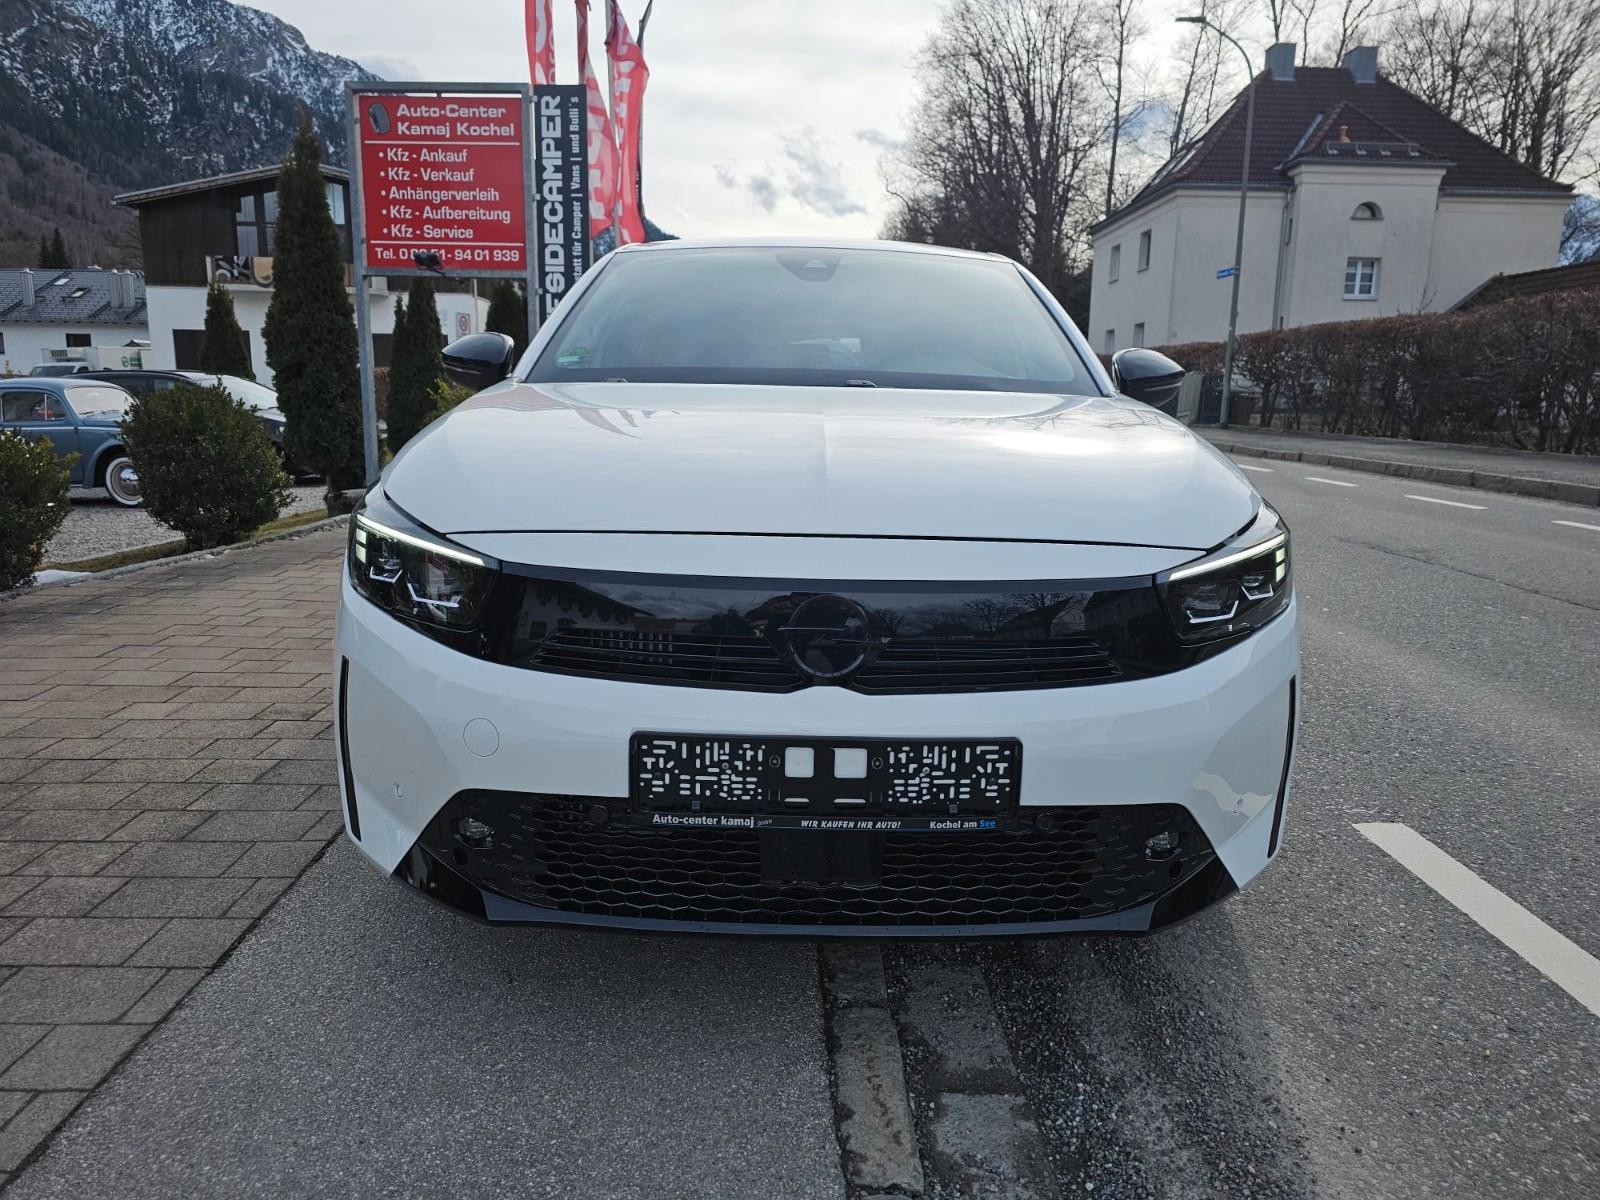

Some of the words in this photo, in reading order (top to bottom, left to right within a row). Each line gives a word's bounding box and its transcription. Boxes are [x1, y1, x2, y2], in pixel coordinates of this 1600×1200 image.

[397, 104, 506, 118] Auto-Center
[397, 122, 450, 138] Kamaj
[456, 122, 515, 137] Kochel
[570, 133, 580, 154] und
[387, 148, 409, 162] Kfz
[420, 148, 468, 162] Ankauf
[388, 167, 411, 181] Kfz
[420, 168, 475, 182] Verkauf
[571, 165, 581, 189] Vans
[389, 186, 499, 203] Anhängerverleih
[390, 205, 412, 219] Kfz
[422, 206, 511, 224] Aufbereitung
[572, 201, 583, 239] Camper
[391, 224, 413, 238] Kfz
[423, 225, 474, 239] Service
[375, 248, 396, 260] Tel.
[493, 249, 519, 262] 939
[572, 241, 582, 257] für
[653, 814, 718, 825] Auto-center
[721, 815, 755, 828] kamaj
[801, 819, 819, 828] WIR
[821, 820, 855, 829] KAUFEN
[857, 820, 873, 829] IHR
[876, 820, 901, 829] AUTO!
[930, 820, 961, 829] Kochel
[963, 821, 978, 829] am
[979, 819, 997, 828] See
